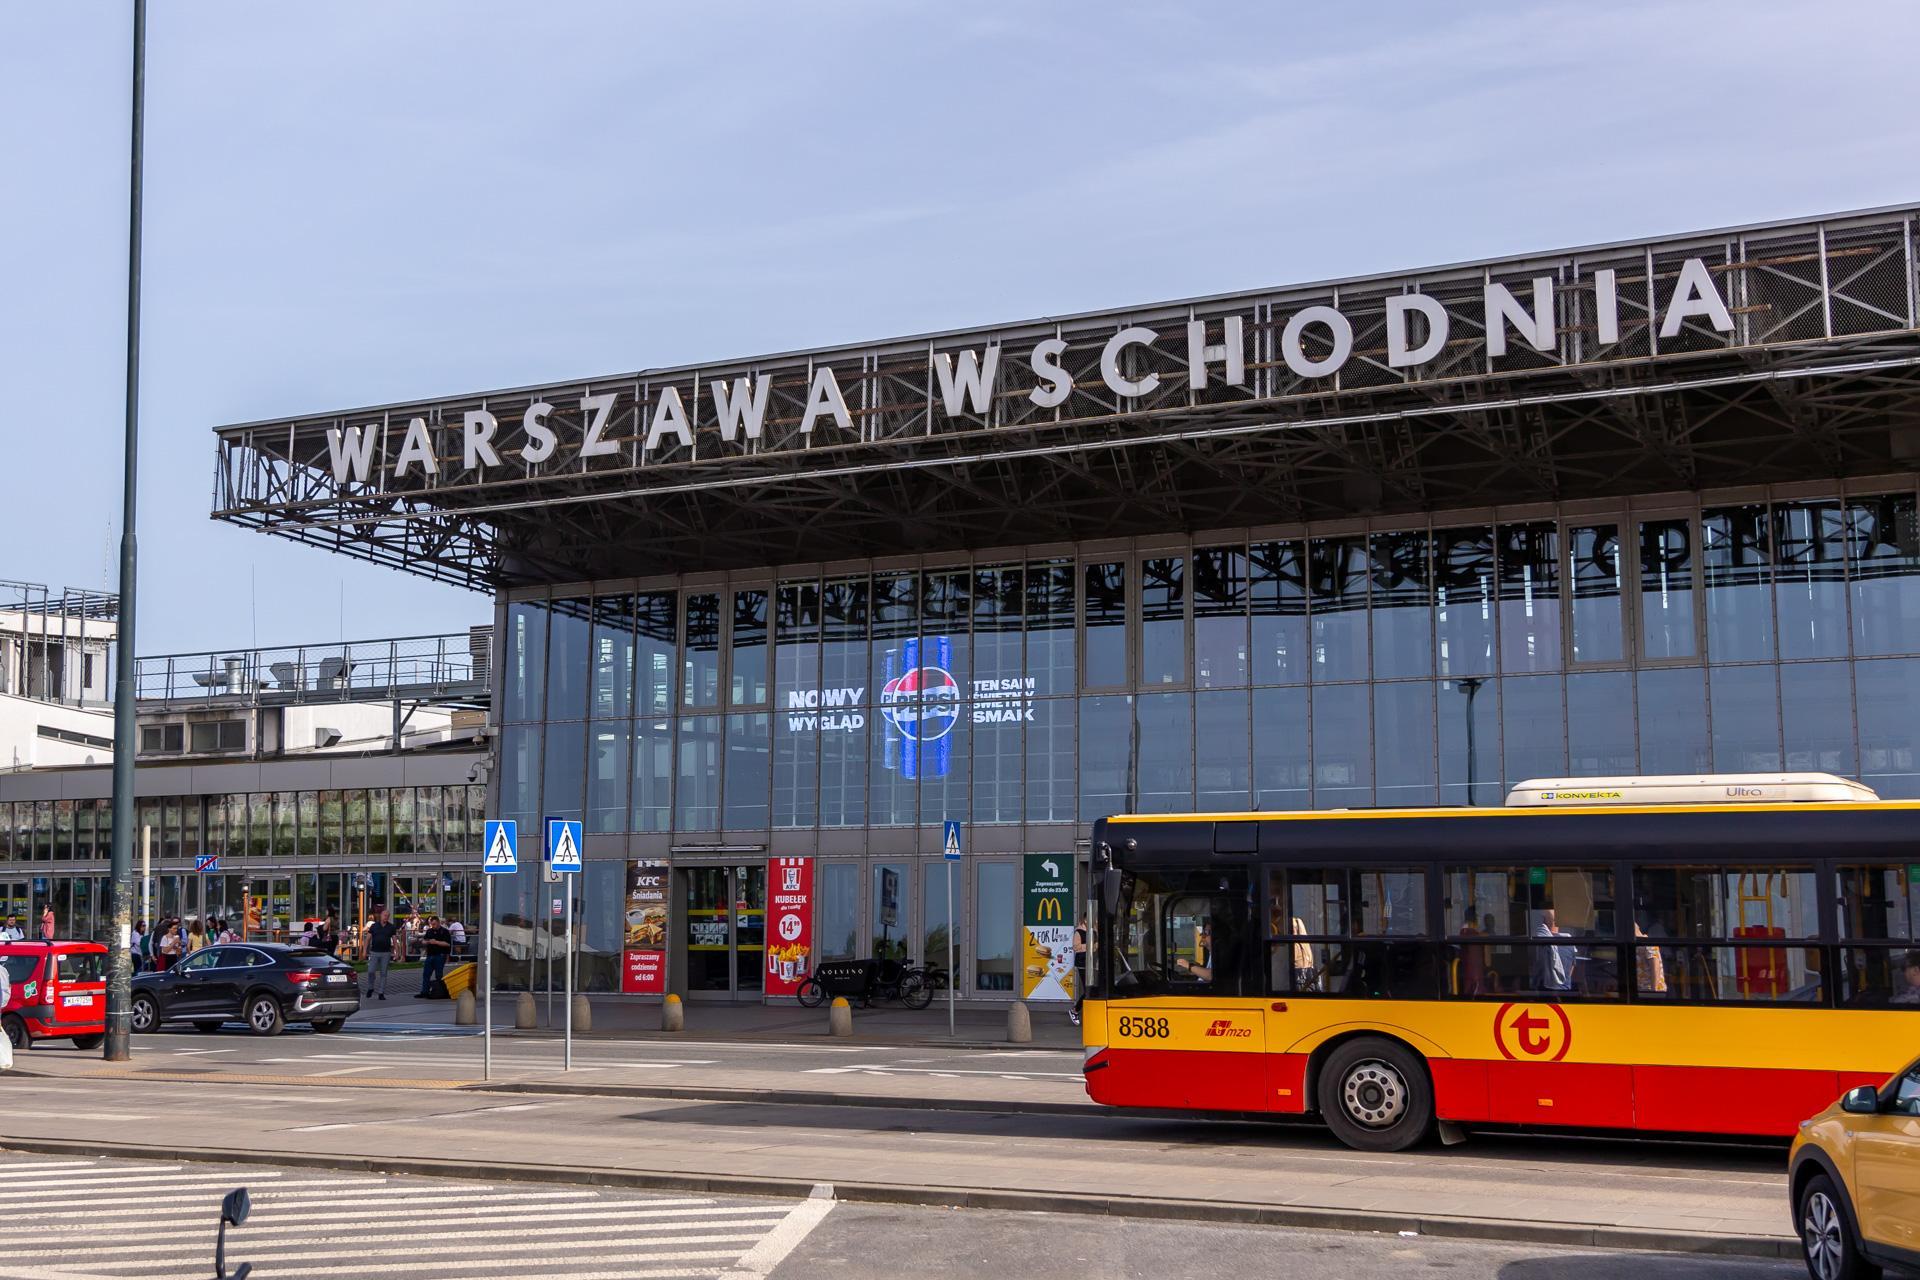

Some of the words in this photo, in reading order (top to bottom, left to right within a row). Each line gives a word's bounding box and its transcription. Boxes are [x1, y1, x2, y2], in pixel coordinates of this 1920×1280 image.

[934, 258, 1735, 418] WSCHODNIA
[326, 366, 854, 484] WARSZAWA
[974, 680, 1000, 691] TEN
[1001, 677, 1035, 690] SAM
[788, 687, 865, 714] NOWY
[896, 692, 956, 715] PEPSI
[973, 708, 1036, 724] SMAK
[788, 714, 865, 733] WYGLĄD
[1555, 791, 1621, 800] KONVEKTA
[1725, 786, 1762, 797] Ultra
[197, 857, 218, 870] TAXI
[637, 876, 660, 886] KFC
[632, 889, 663, 900] Śniadania
[775, 895, 807, 904] KUBEŁEK
[781, 920, 793, 935] 14
[1037, 930, 1051, 944] FOR
[629, 952, 660, 962] Zapraszamy
[634, 973, 642, 981] od
[1119, 1015, 1170, 1039] 8588
[1225, 1028, 1252, 1038] mza
